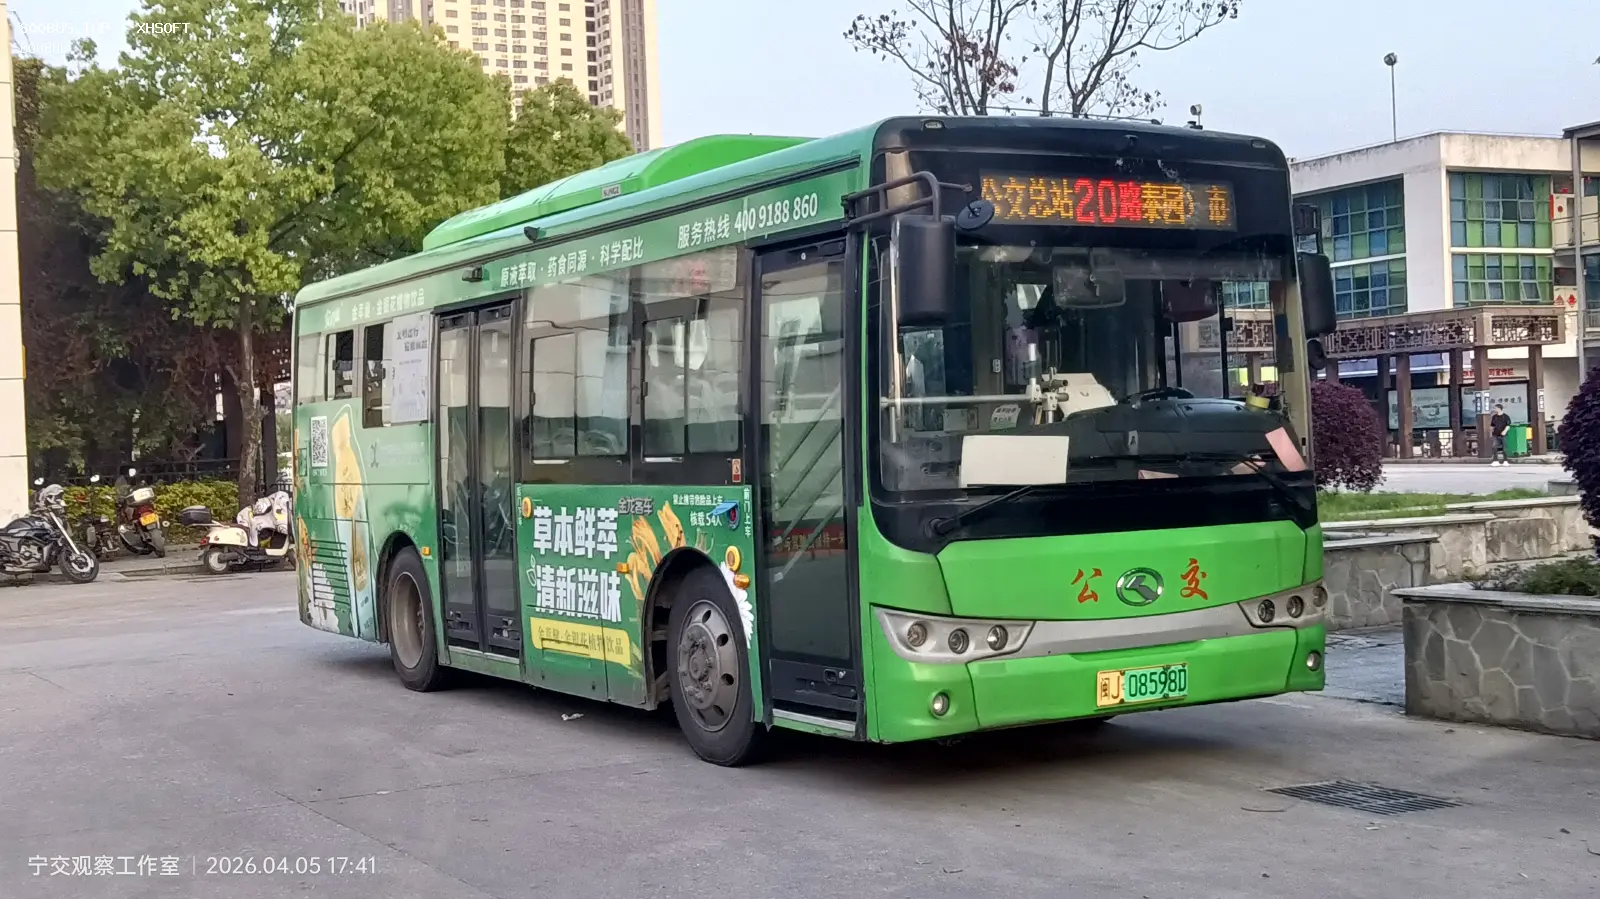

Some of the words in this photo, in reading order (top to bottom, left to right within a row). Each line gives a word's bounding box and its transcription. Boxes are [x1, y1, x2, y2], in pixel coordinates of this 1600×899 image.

[677, 213, 730, 249] 服务热线
[734, 207, 756, 234] 400
[758, 199, 790, 228] 9188
[793, 192, 818, 221] 860
[618, 496, 654, 515] 金龙客车
[743, 487, 752, 538] 前门上车
[533, 506, 618, 559] 草本鲜萃
[536, 563, 622, 622] 清新滋味
[1071, 568, 1102, 604] 公
[1180, 558, 1208, 600] 交
